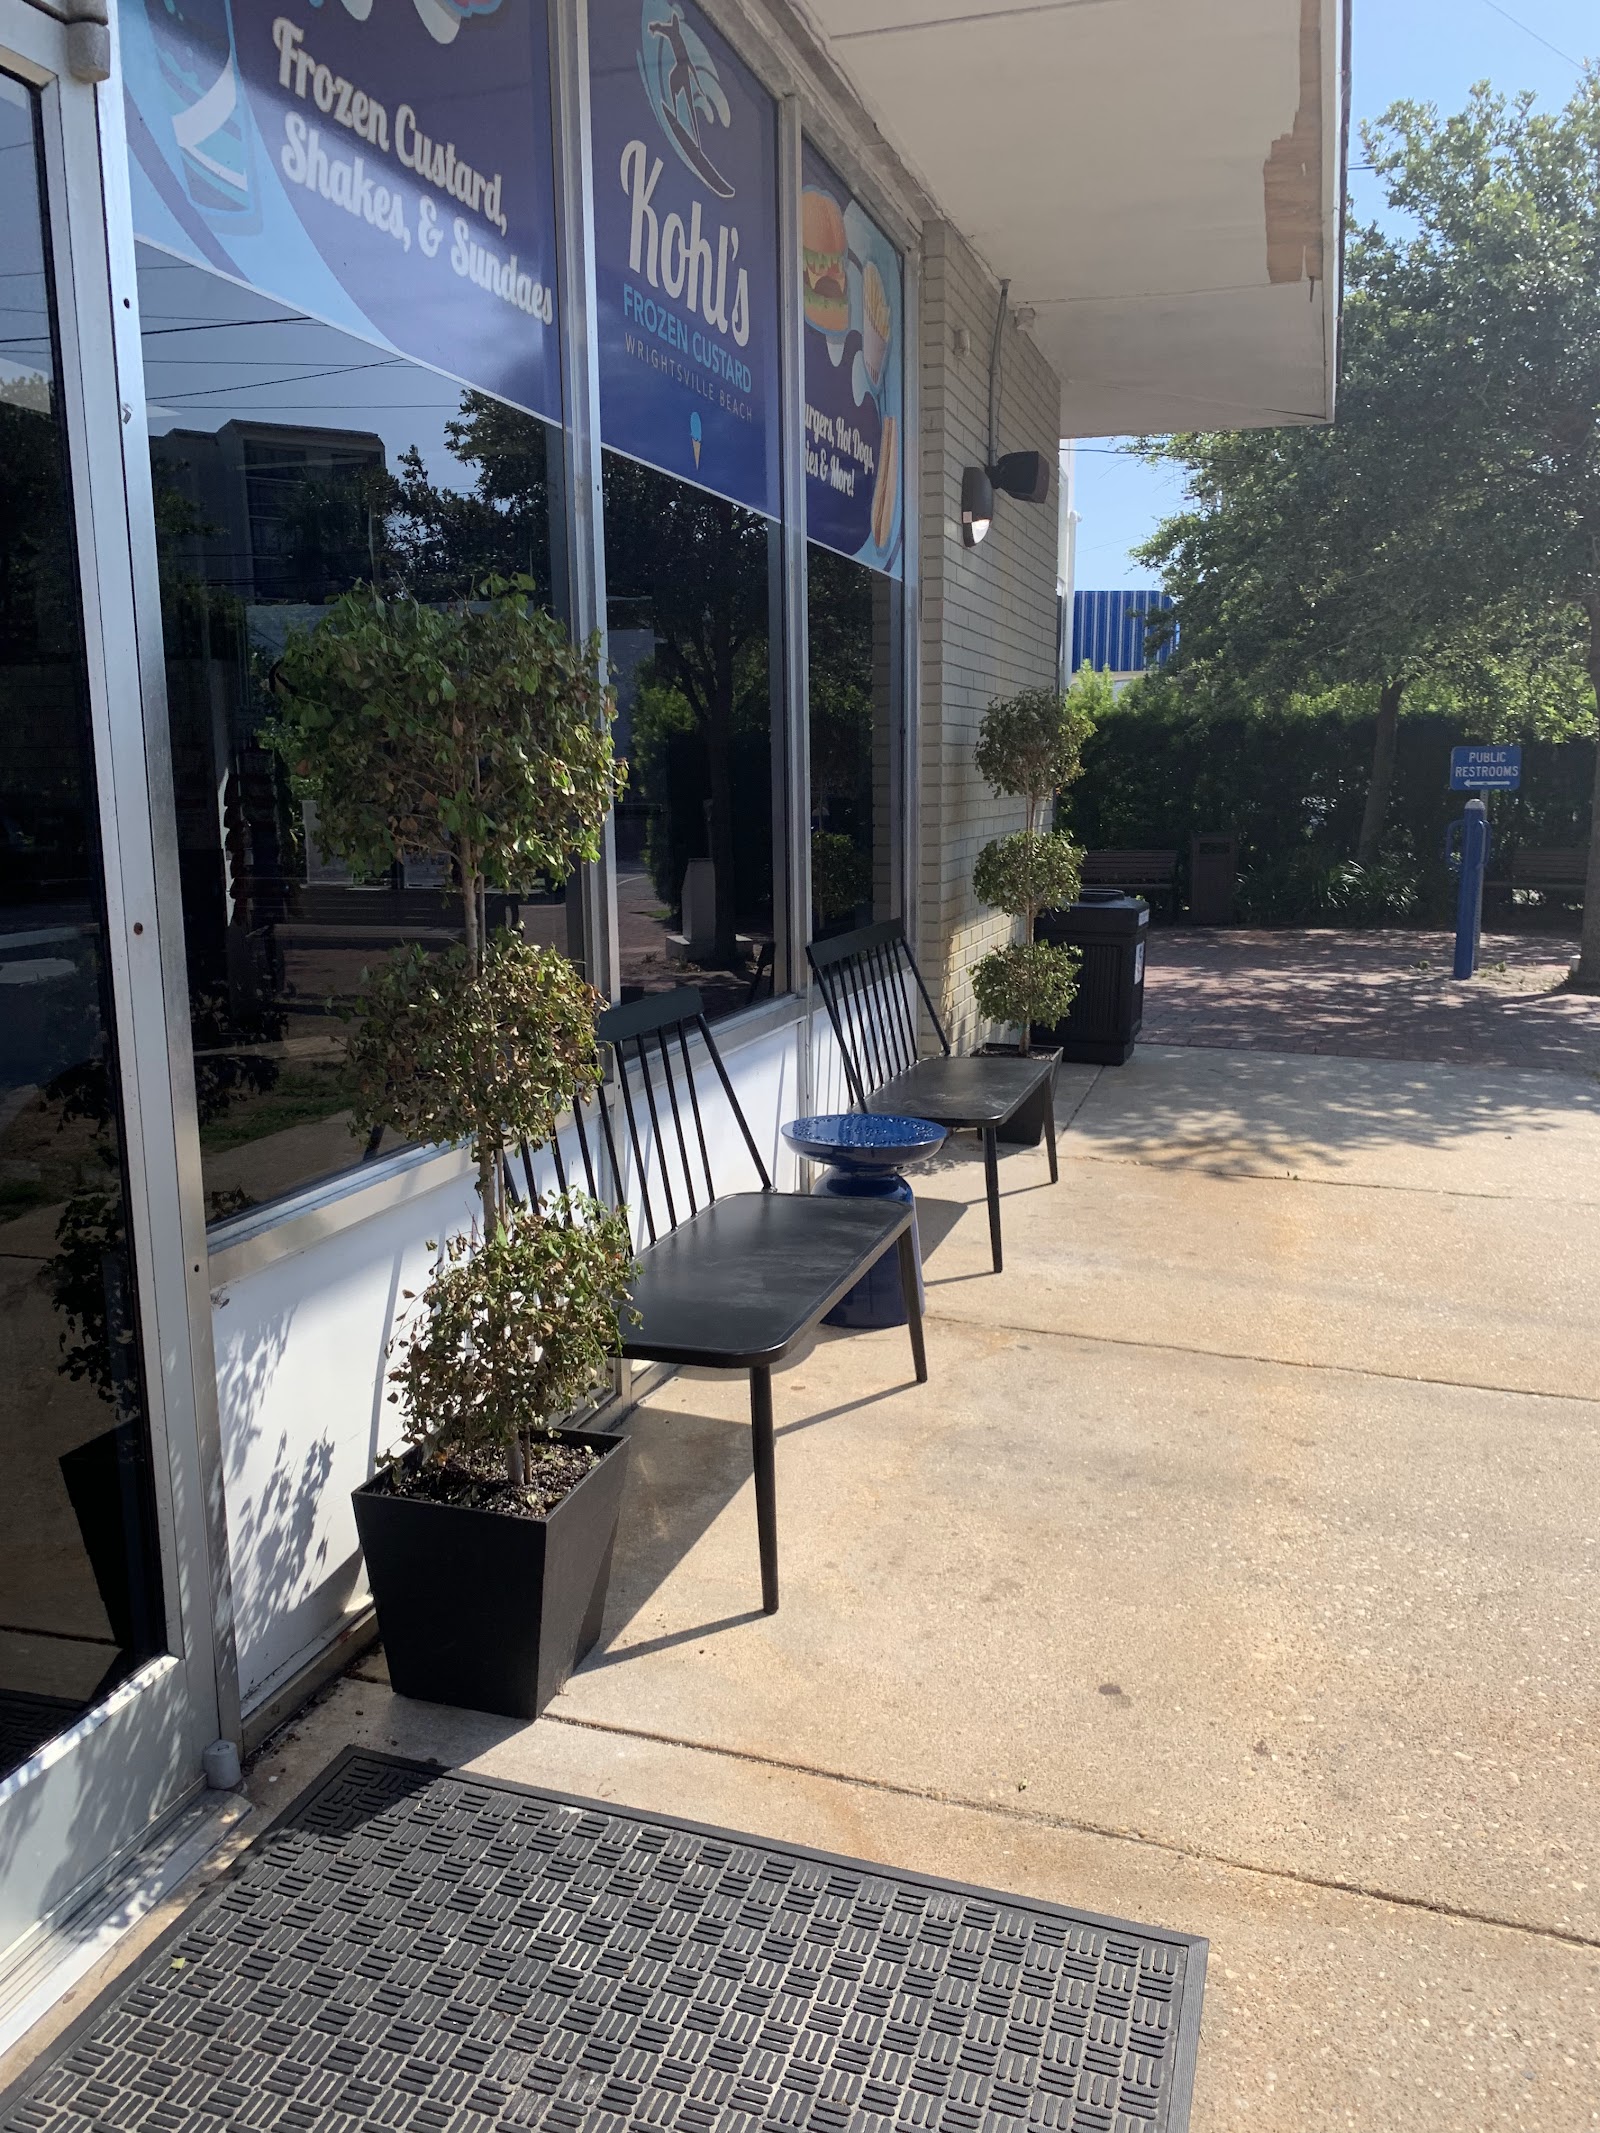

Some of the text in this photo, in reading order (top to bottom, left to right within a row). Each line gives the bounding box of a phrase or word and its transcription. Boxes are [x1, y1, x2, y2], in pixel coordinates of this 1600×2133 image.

[272, 16, 508, 236] Frozen Custard,
[281, 110, 554, 325] Shakes, & Sundaes
[619, 139, 751, 347] Kohl's
[623, 282, 753, 394] FROZEN CUSTARD
[624, 331, 753, 424] WRIGHTSVILLE BEACH
[805, 404, 834, 449] urgers,
[835, 416, 852, 455] Hot
[805, 439, 855, 497] ies & More!
[1455, 766, 1519, 777] RESTROOMS
[1468, 752, 1507, 763] PUBLIC
